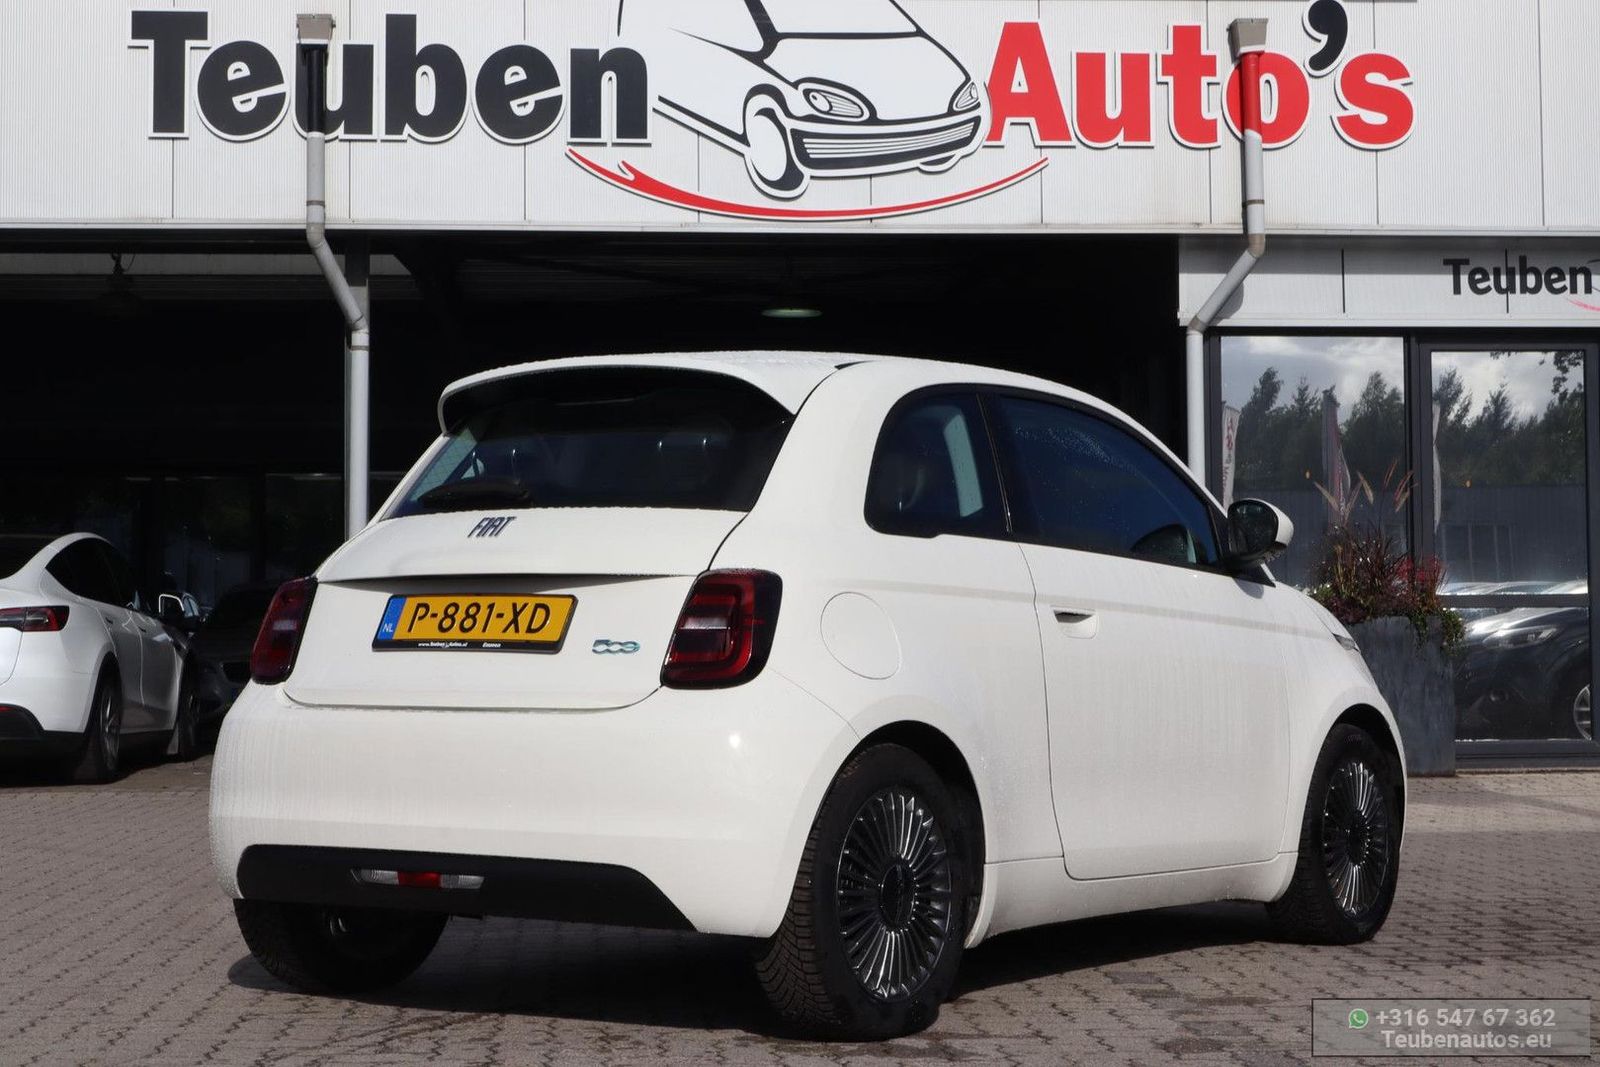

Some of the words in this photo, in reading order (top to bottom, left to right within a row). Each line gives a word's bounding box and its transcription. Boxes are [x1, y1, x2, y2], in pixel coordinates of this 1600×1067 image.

[130, 10, 649, 141] Teuben
[987, 0, 1414, 146] Auto's
[1443, 255, 1592, 295] Teuben
[467, 516, 517, 538] FIAT
[382, 623, 394, 633] NL
[407, 602, 551, 634] P-881-XD
[592, 639, 640, 654] 500
